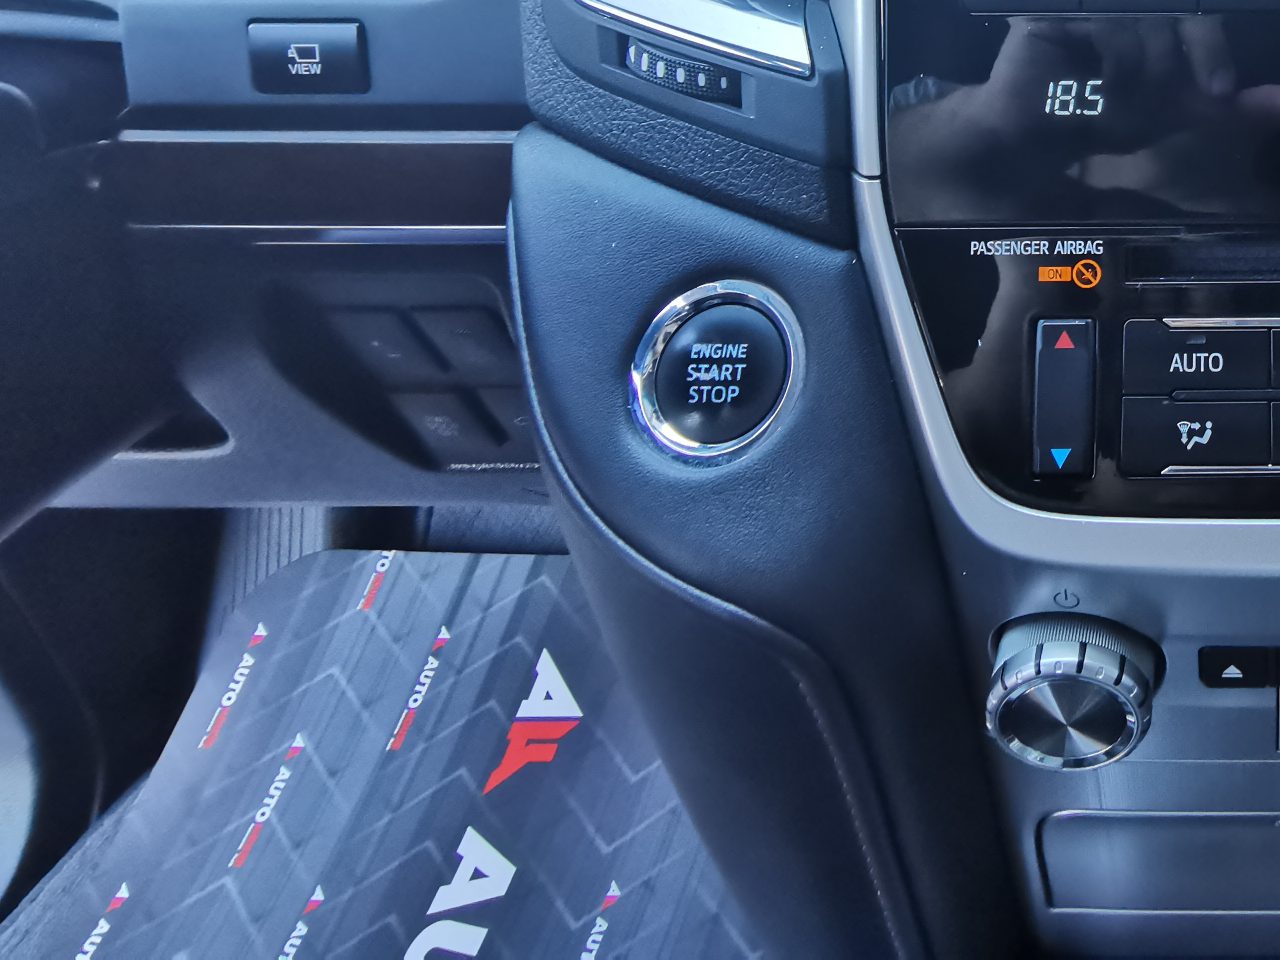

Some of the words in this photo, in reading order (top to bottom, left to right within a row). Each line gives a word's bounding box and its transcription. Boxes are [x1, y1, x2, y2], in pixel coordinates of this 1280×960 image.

[288, 63, 322, 75] VIEW
[1045, 80, 1105, 116] 18.5
[970, 241, 1049, 257] PASSENGER
[1054, 240, 1104, 256] AIRBAG
[1047, 268, 1063, 280] ON
[690, 343, 748, 359] ENGINE
[1169, 352, 1224, 373] AUTO
[686, 363, 747, 381] START
[688, 385, 740, 403] STOP
[221, 652, 256, 707] AUTO
[408, 655, 439, 709] AUTO
[255, 765, 292, 823] AUTO
